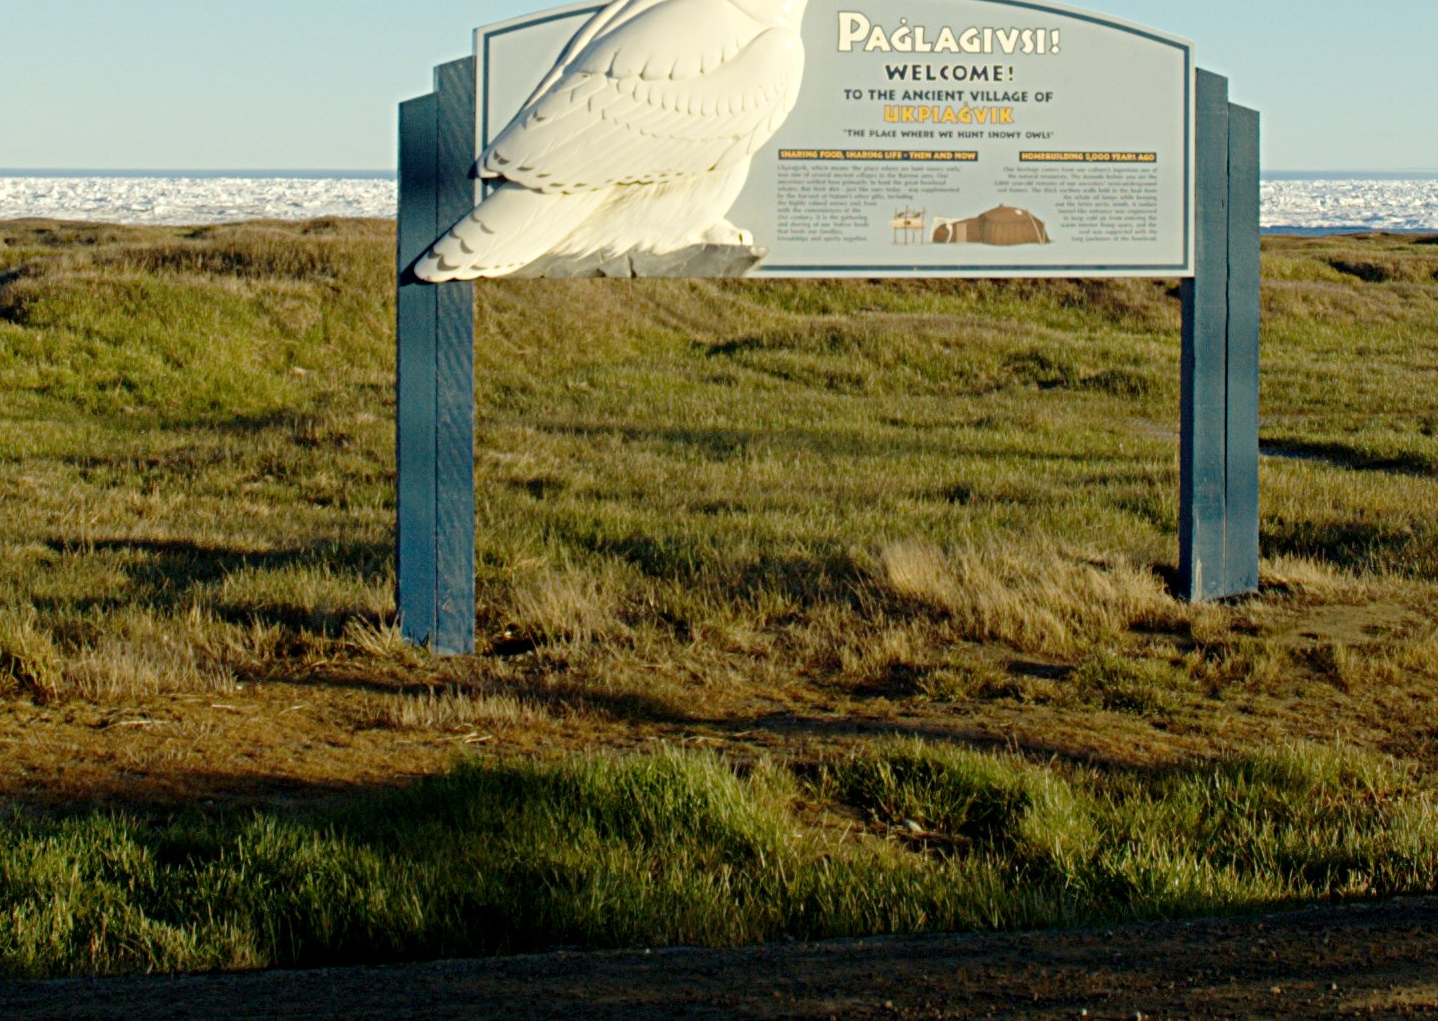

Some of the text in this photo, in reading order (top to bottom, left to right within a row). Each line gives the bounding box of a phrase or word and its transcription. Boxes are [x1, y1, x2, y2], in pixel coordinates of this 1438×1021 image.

[885, 64, 1014, 81] WELCOME!
[844, 89, 1053, 102] TO THE ANCIENT VILLAGE OF
[900, 130, 934, 138] WHERE
[780, 151, 818, 159] SHARING
[846, 151, 883, 159] SHARING
[884, 151, 902, 159] LIFE
[908, 152, 932, 160] THEN
[933, 152, 953, 160] AND
[954, 152, 976, 160] NOW
[1112, 153, 1137, 161] YEARS
[1137, 153, 1156, 161] AGO
